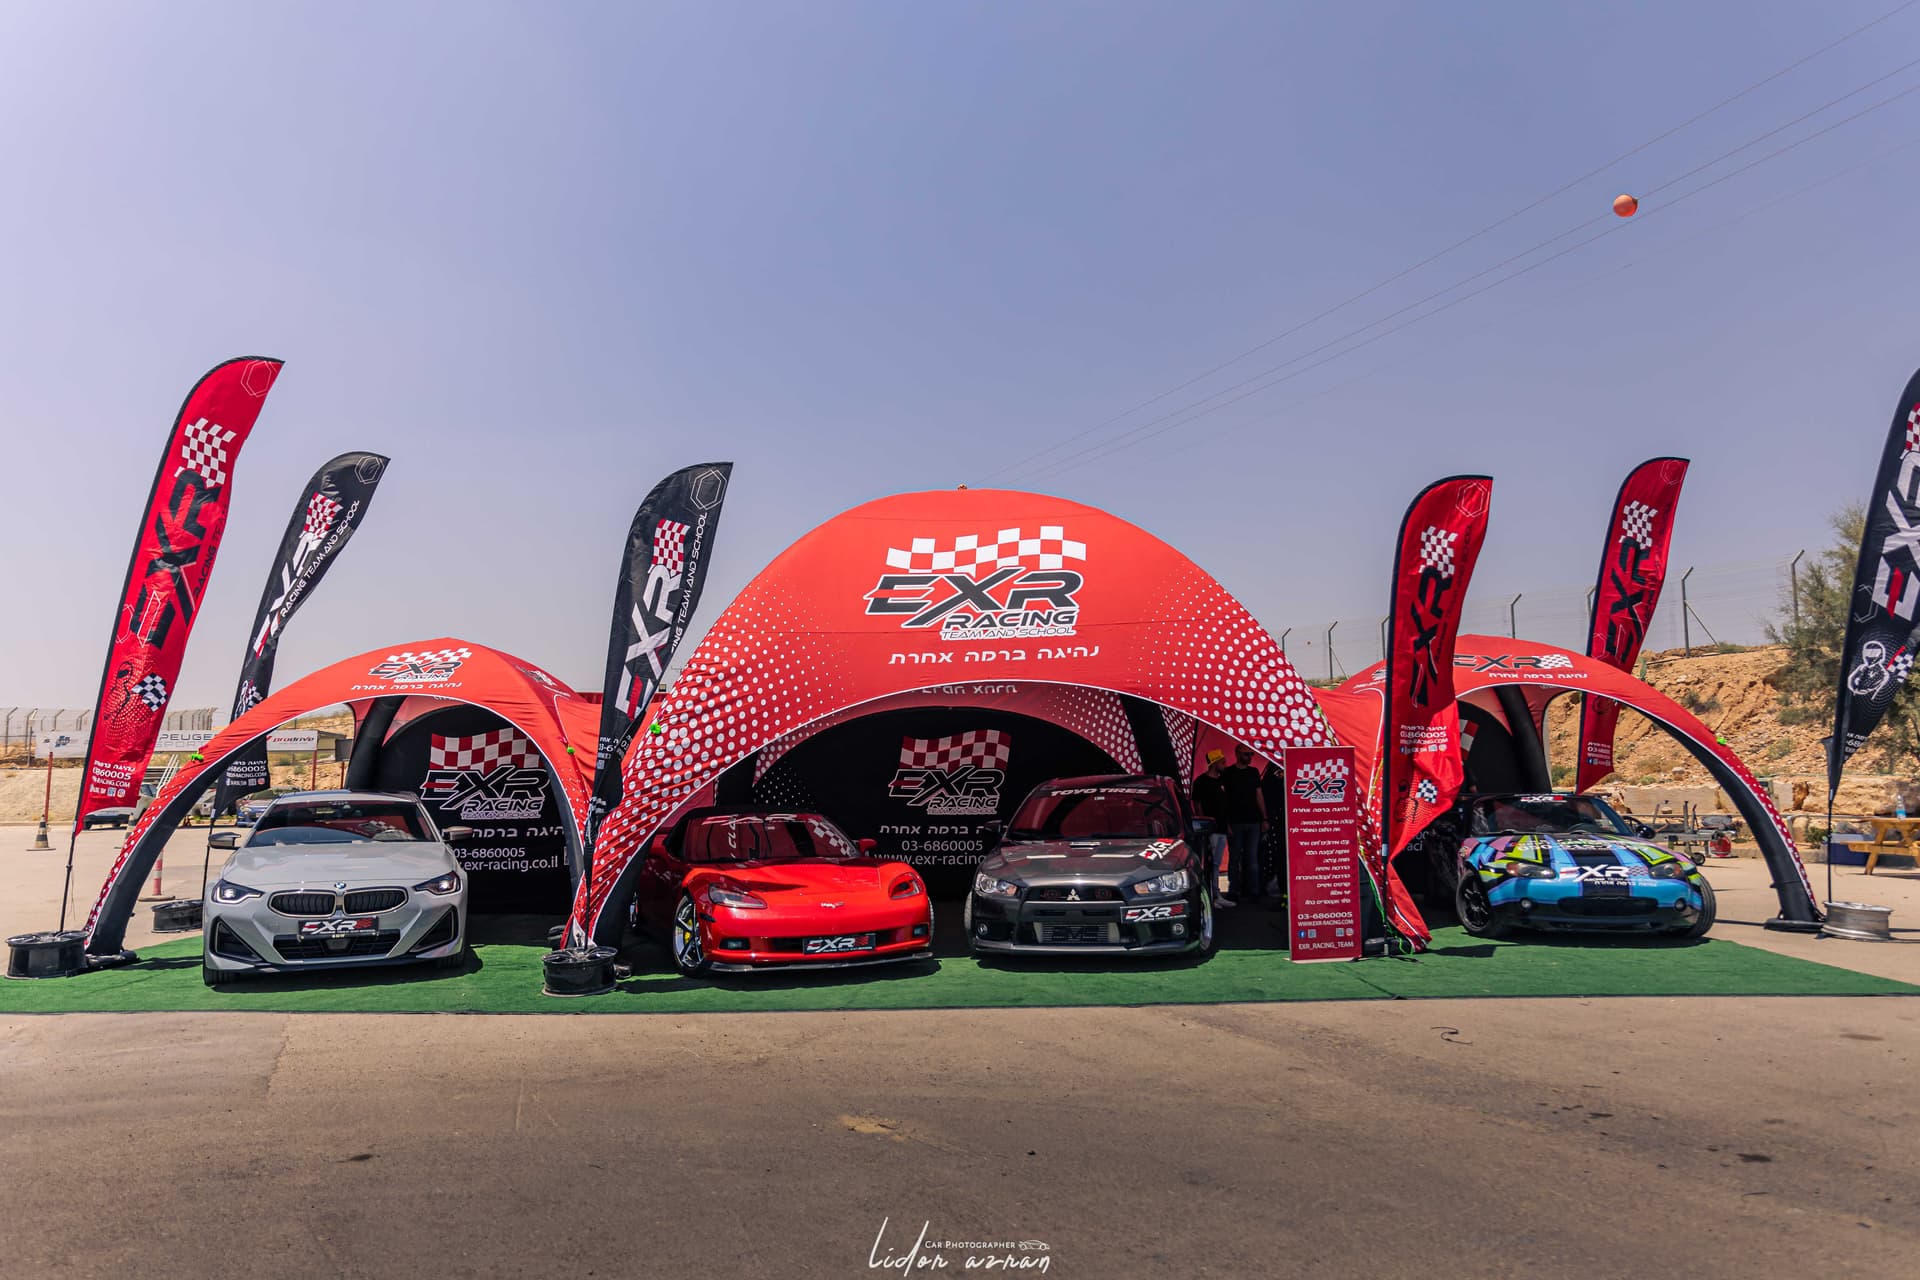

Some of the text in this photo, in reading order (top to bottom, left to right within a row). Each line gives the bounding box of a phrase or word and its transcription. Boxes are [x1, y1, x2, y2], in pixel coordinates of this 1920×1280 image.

[691, 511, 708, 560] SCHOOL
[131, 467, 222, 651] EXR
[279, 499, 361, 618] RACING TEAM AND SCHOOL
[686, 560, 697, 588] AND
[253, 531, 324, 660] EXR
[863, 565, 1085, 629] EXR
[1605, 536, 1650, 664] EXR
[678, 589, 692, 624] TEAM
[943, 610, 1078, 629] RACING
[615, 562, 684, 722] EXR
[941, 626, 1077, 640] TEAM AND SCHOOL
[1408, 565, 1451, 706] EXR
[888, 646, 1100, 666] נהיגה ברמה אחרת
[1453, 654, 1543, 673] EXR
[368, 661, 464, 680] EXR
[160, 733, 216, 741] PEUGE
[419, 764, 550, 811] EXR
[887, 765, 1005, 806] EXR
[1051, 788, 1098, 797] TOYO
[1291, 776, 1347, 799] EXR
[463, 799, 544, 812] RACING
[929, 797, 999, 809] RACING
[472, 826, 565, 838] היגה ברמה
[879, 825, 921, 835] אחרת
[927, 825, 969, 835] ברמה
[453, 847, 526, 858] 03-6860005
[901, 840, 983, 851] 03-6860005
[457, 856, 559, 872] .exr-racing.co.il
[1558, 864, 1630, 882] EXR
[1125, 906, 1172, 922] EXR
[1297, 911, 1353, 920] 03-6860005
[302, 920, 358, 935] EXR
[806, 937, 856, 953] EXR
